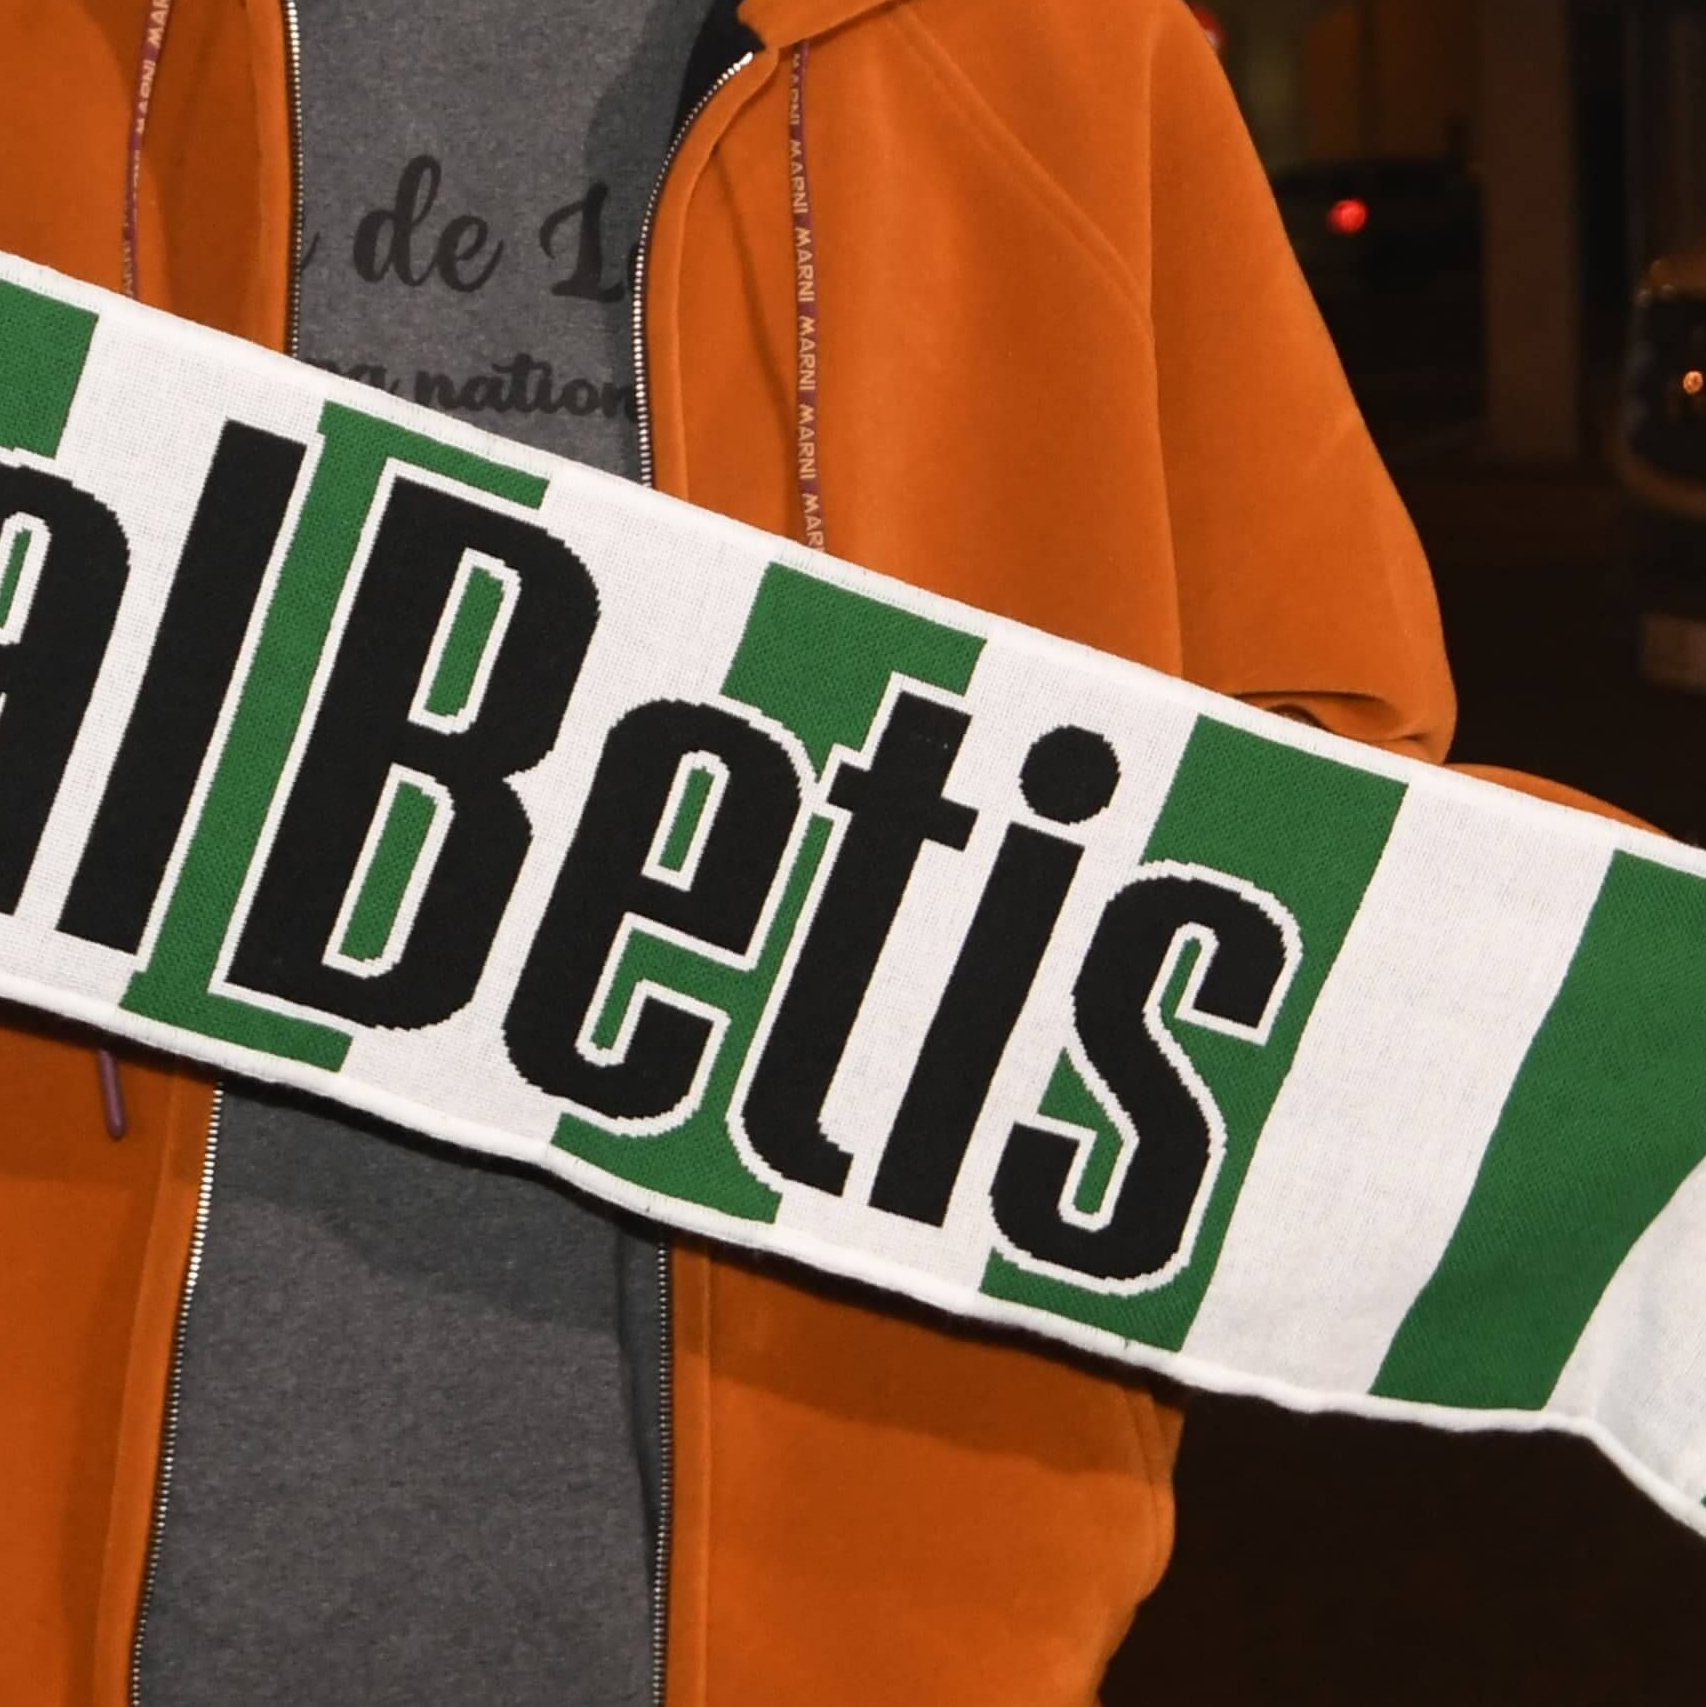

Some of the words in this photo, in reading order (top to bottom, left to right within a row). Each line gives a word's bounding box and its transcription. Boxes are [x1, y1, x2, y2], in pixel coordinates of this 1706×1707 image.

[789, 139, 809, 214] MARNI
[353, 154, 504, 293] de
[795, 226, 816, 302] MARNI
[798, 315, 816, 391] MARNI
[797, 403, 817, 480] MARNI
[802, 493, 826, 552] MAR
[224, 475, 1291, 1286] Betis
